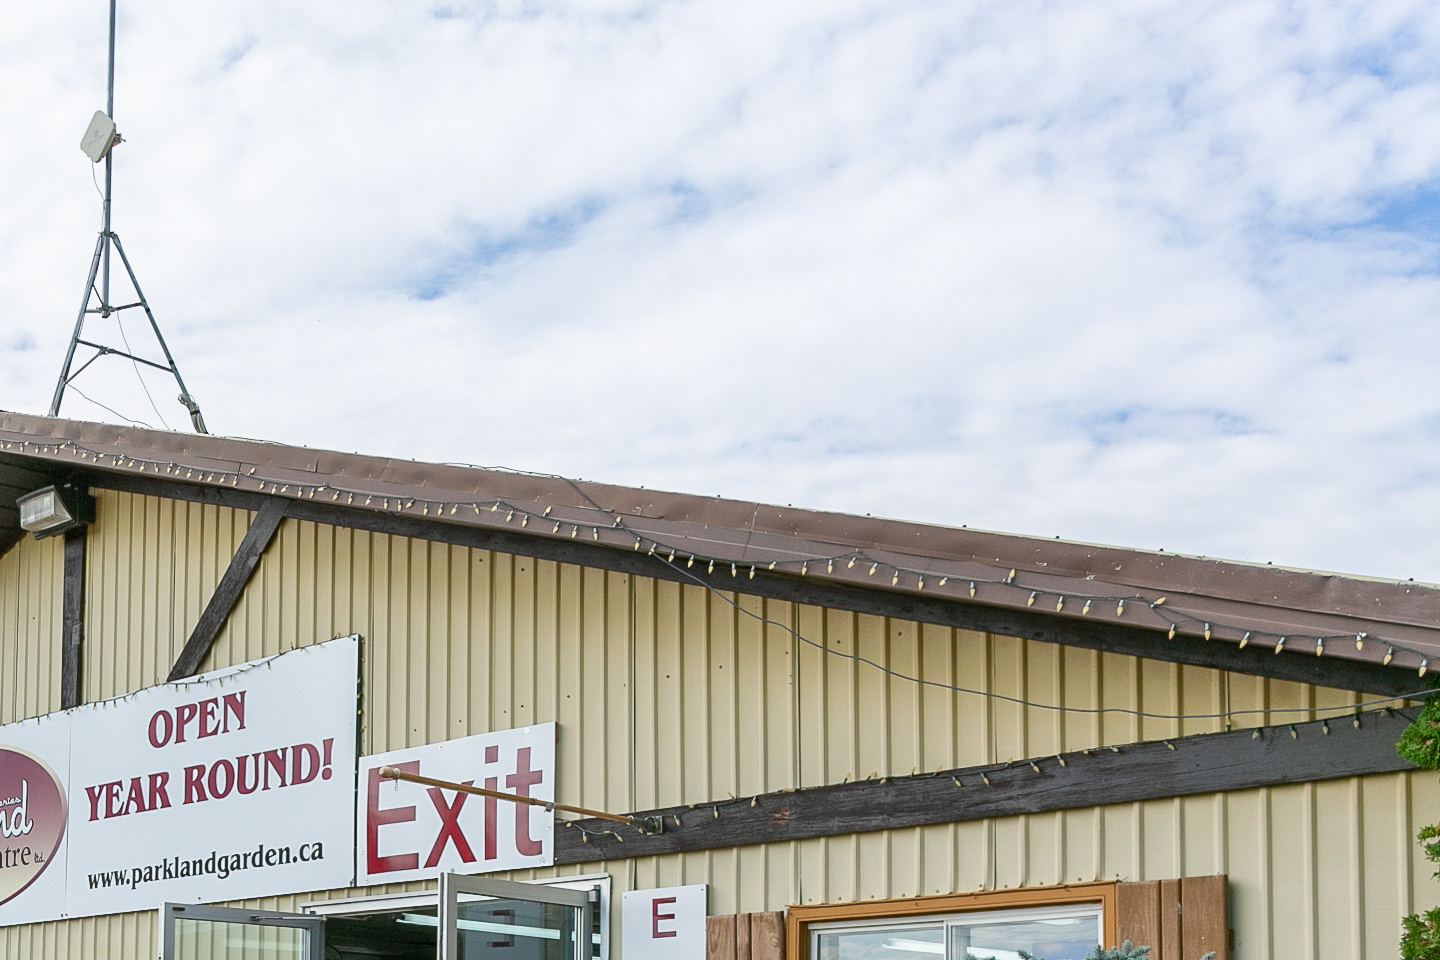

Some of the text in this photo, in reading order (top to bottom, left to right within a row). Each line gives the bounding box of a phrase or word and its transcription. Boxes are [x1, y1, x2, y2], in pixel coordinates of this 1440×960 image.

[148, 690, 247, 748] OPEN
[84, 738, 335, 822] YEAR ROUND!
[367, 745, 543, 875] Exit
[34, 852, 46, 863] ltd.
[87, 841, 324, 890] www.parklandgarden.ca
